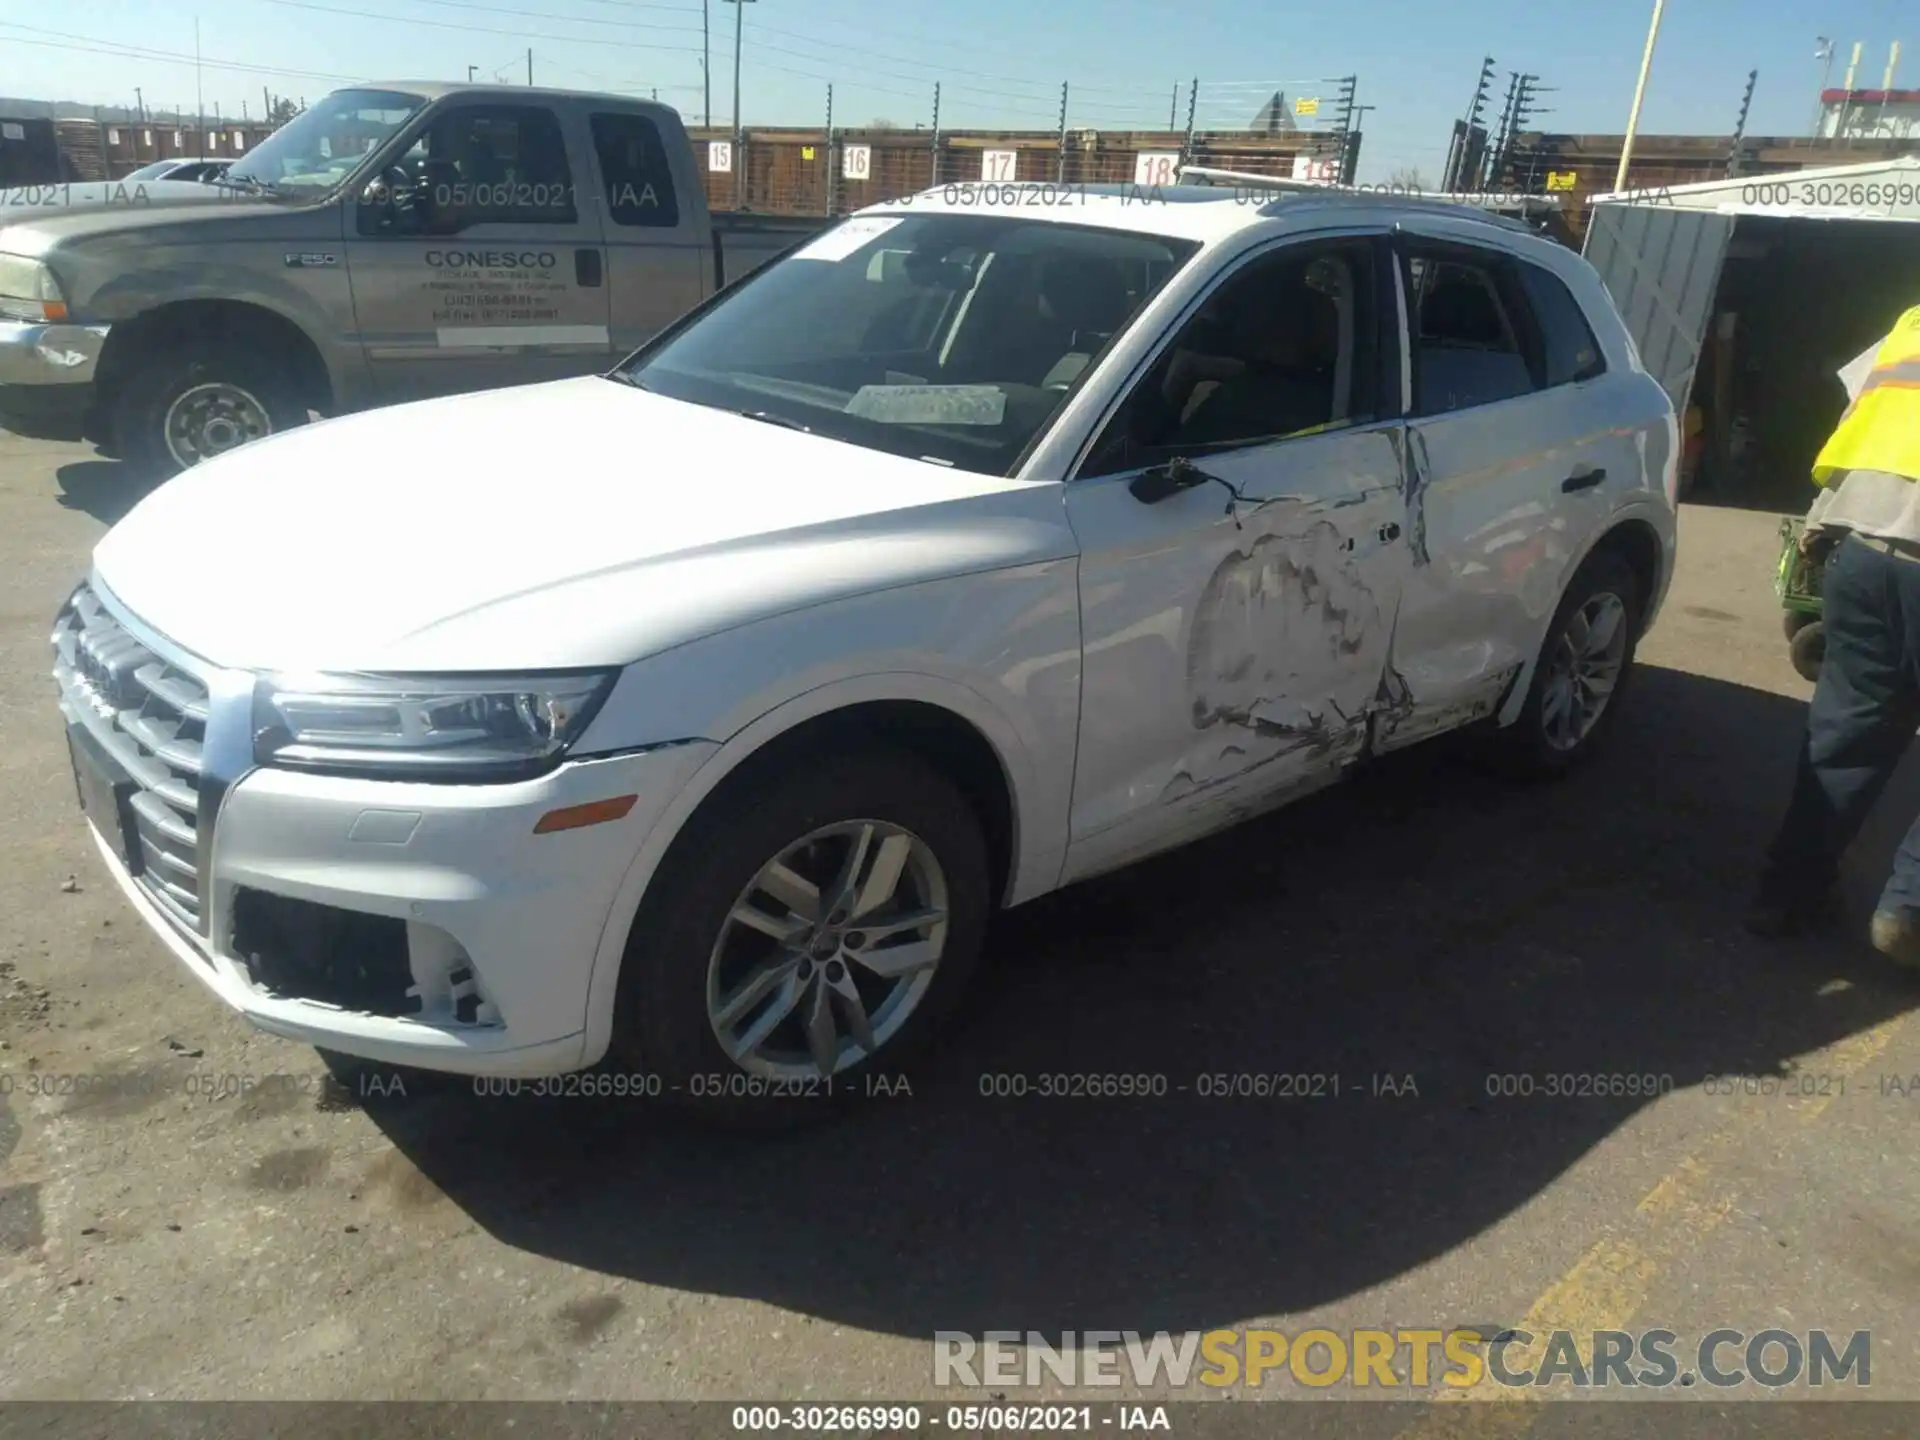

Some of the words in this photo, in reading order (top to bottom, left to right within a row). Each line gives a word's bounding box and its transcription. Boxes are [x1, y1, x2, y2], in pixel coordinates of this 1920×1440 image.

[713, 146, 729, 166] 15
[848, 150, 867, 173] 16
[989, 153, 1011, 181] 17
[1144, 156, 1170, 185] 18
[425, 250, 557, 268] CONESCO
